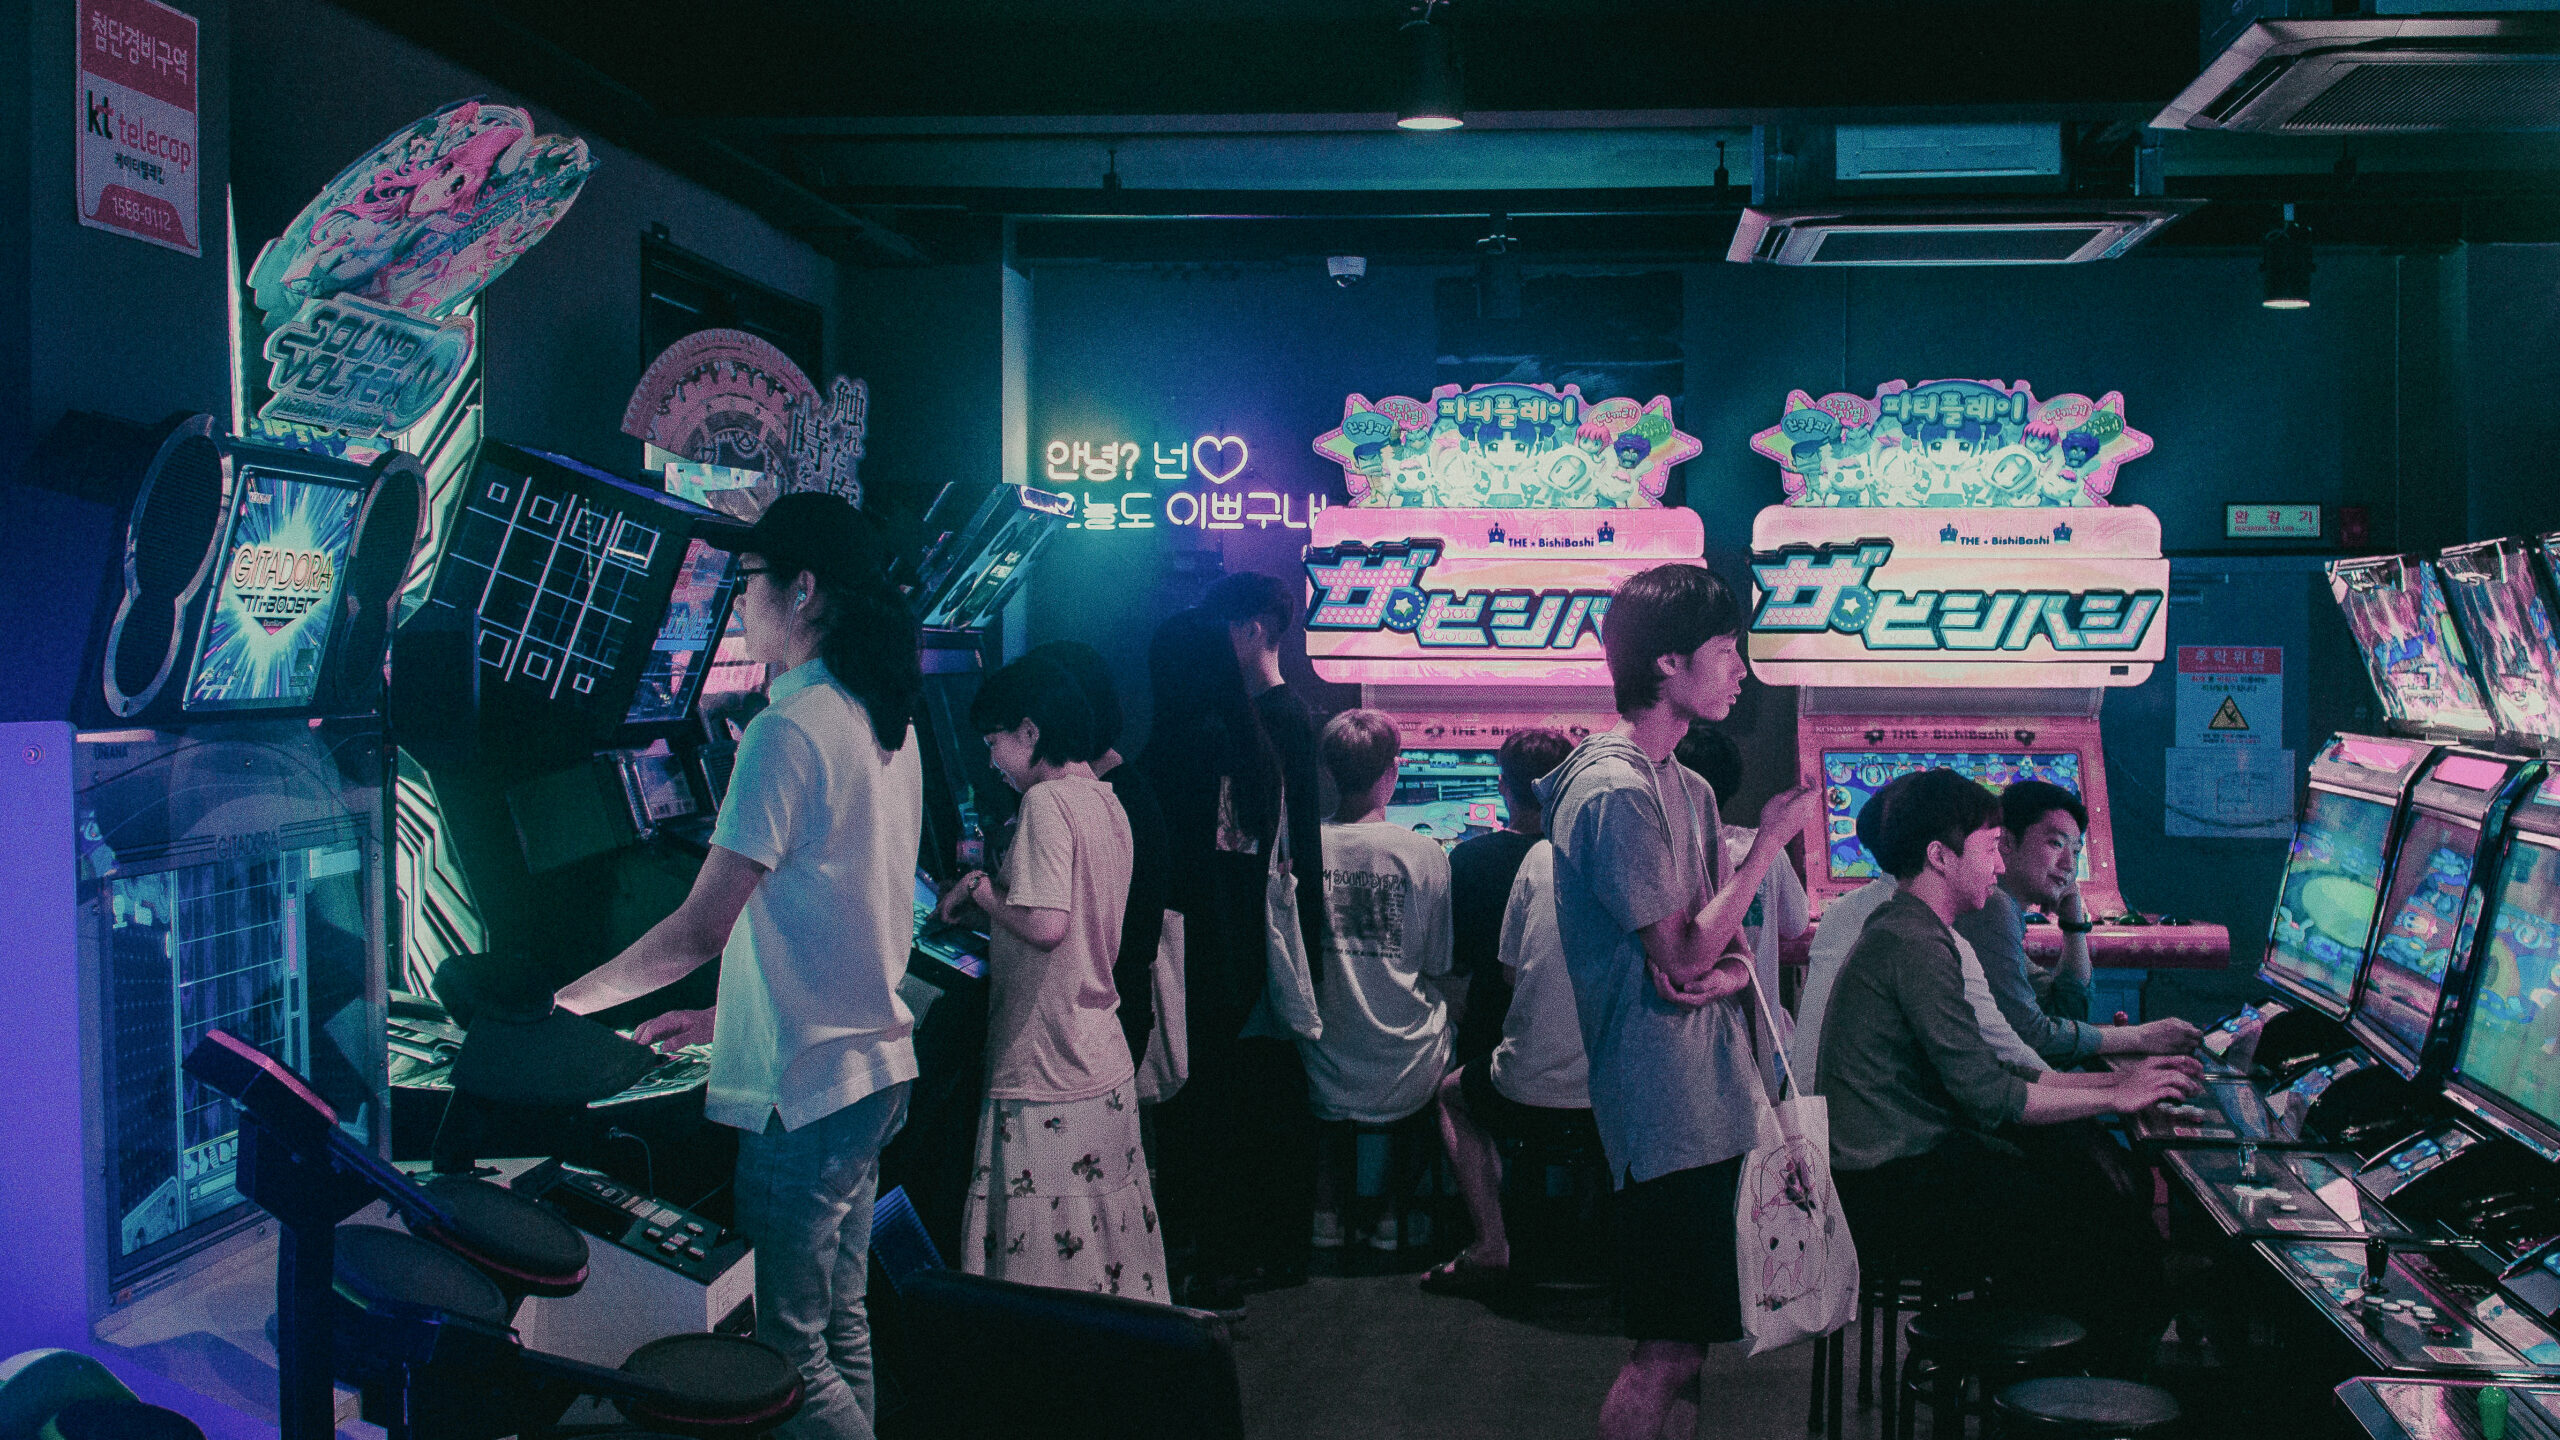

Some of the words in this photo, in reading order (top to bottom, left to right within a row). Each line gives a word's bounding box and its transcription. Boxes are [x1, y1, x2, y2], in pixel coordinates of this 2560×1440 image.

[92, 10, 188, 85] 첨단경비구역
[86, 89, 114, 140] kt
[118, 112, 191, 174] telecop
[277, 309, 421, 369] SOUND
[1438, 395, 1577, 430] 파티플레이
[1882, 391, 2026, 427] 파티플레이
[1047, 440, 1140, 482] 안녕?
[1153, 441, 1188, 480] 넌
[1508, 537, 1528, 548] THE
[1538, 536, 1595, 548] BishiBashi
[1960, 536, 1980, 545] THE
[1991, 535, 2050, 545] BishiBashi
[233, 544, 335, 593] GITADORA
[1333, 869, 1369, 887] SOUND
